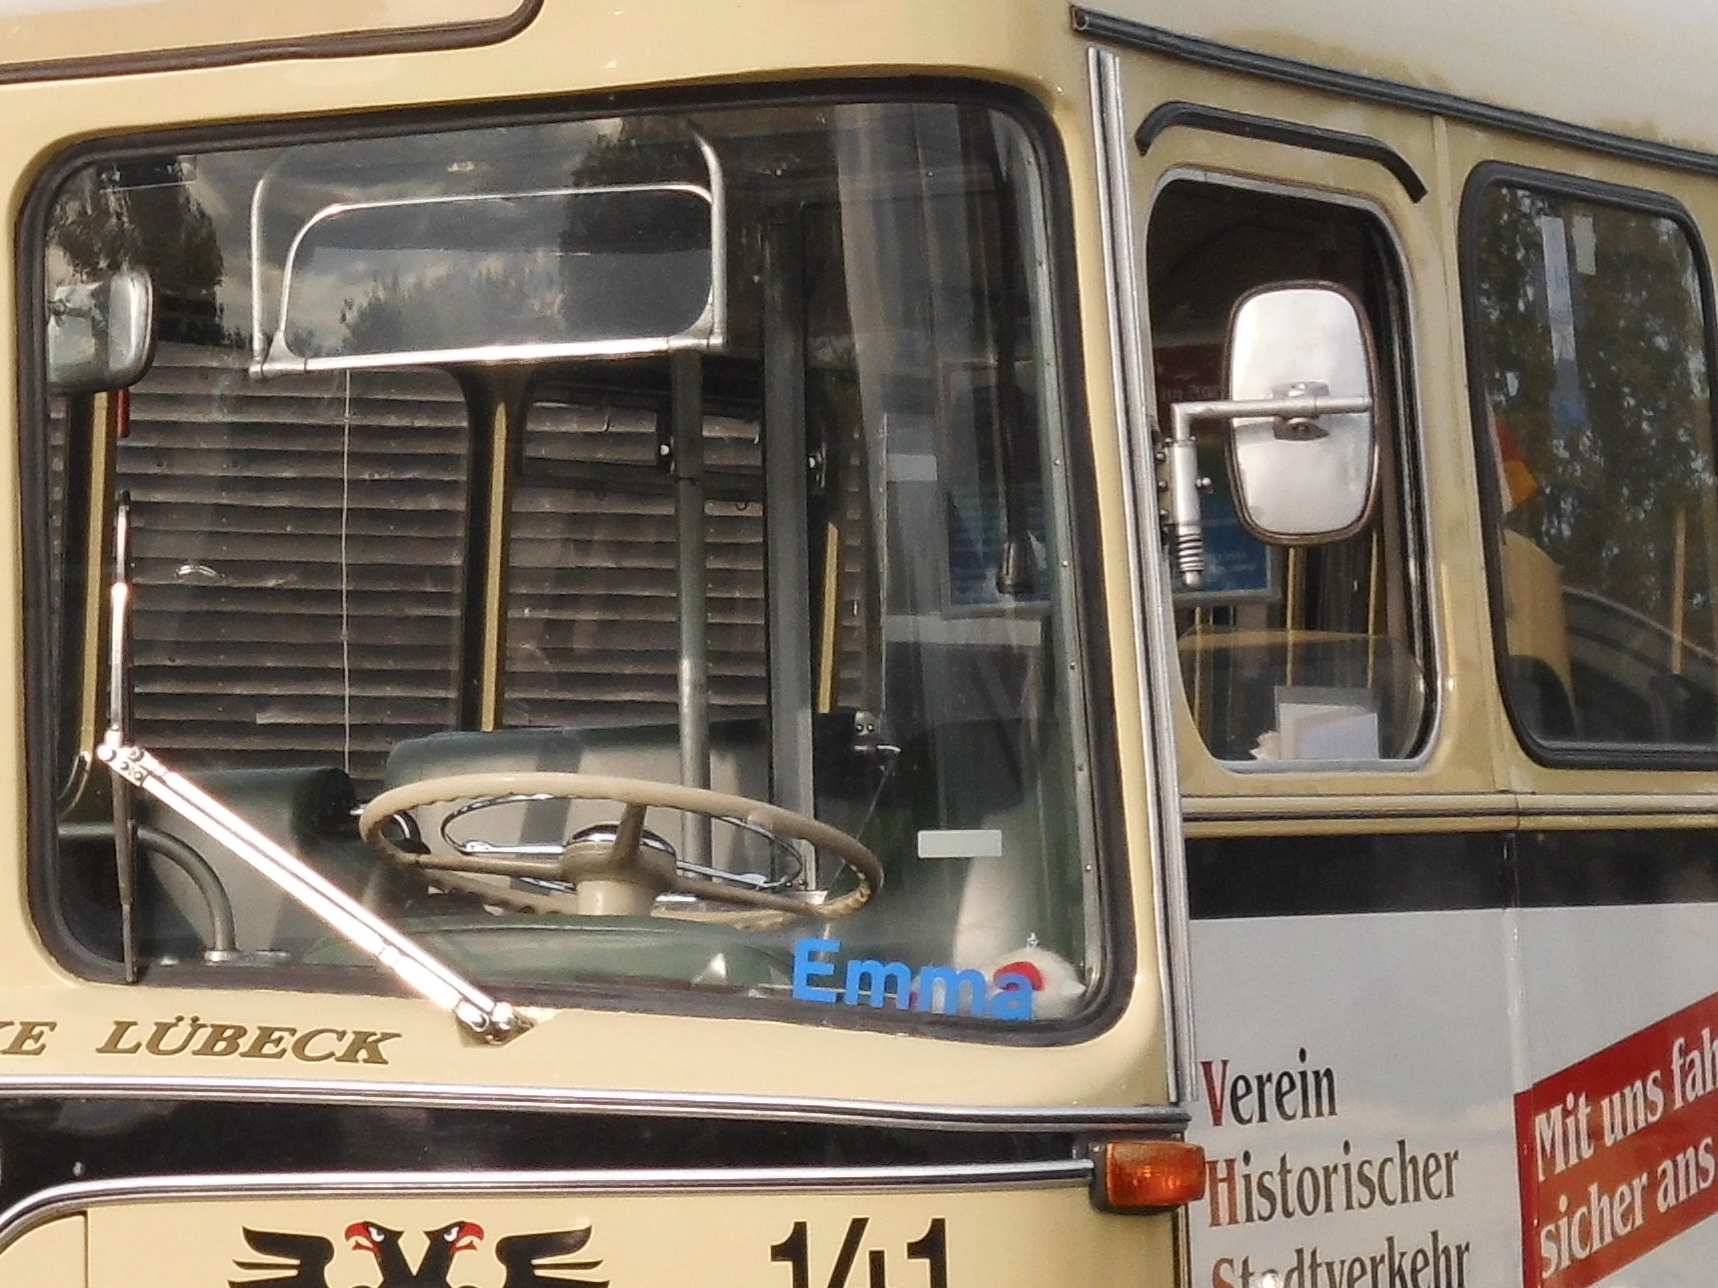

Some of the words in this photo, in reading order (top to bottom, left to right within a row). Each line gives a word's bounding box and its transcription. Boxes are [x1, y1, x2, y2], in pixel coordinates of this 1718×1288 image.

[792, 937, 1034, 1022] Emma
[97, 1014, 403, 1065] LÜBECK
[1200, 1047, 1338, 1127] Verein
[1533, 1098, 1596, 1183] Mit
[1602, 1076, 1665, 1145] uns
[1206, 1140, 1461, 1228] Historischer
[1540, 1181, 1649, 1280] sicher
[1655, 1138, 1716, 1213] ans
